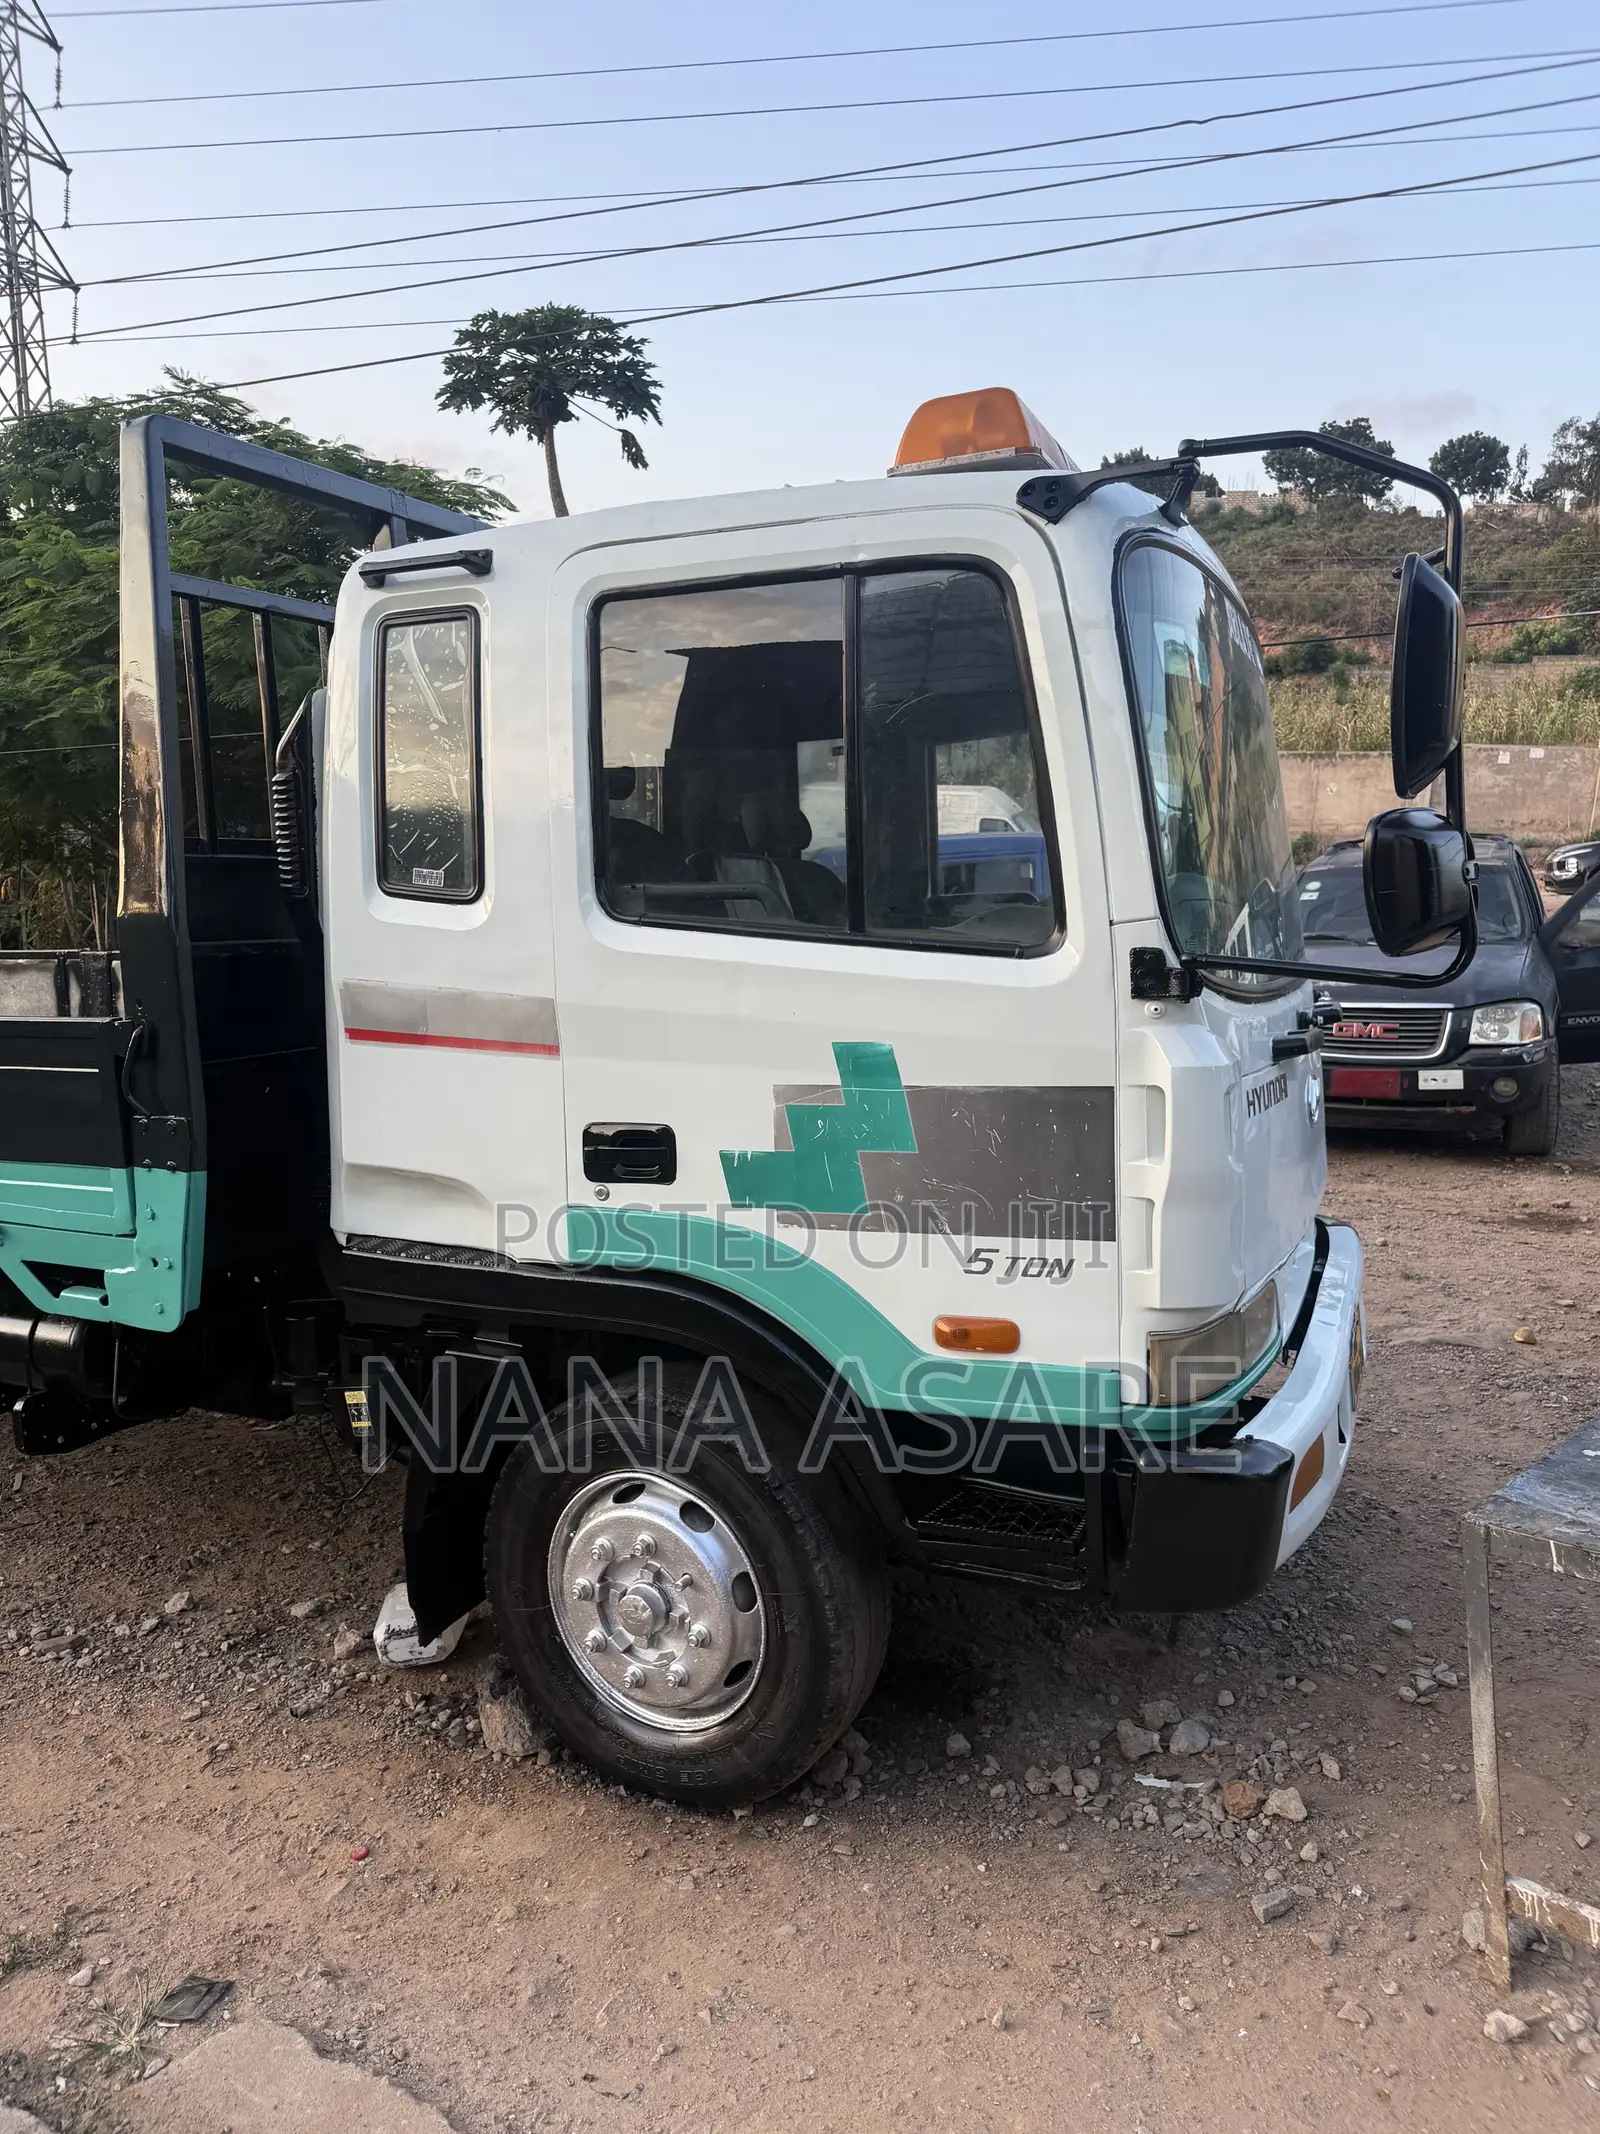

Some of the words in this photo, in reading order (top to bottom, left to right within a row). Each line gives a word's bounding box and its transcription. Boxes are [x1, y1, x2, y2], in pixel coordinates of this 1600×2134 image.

[1333, 1022, 1399, 1039] GMC
[963, 1247, 1000, 1276] 5
[1002, 1255, 1076, 1279] TON
